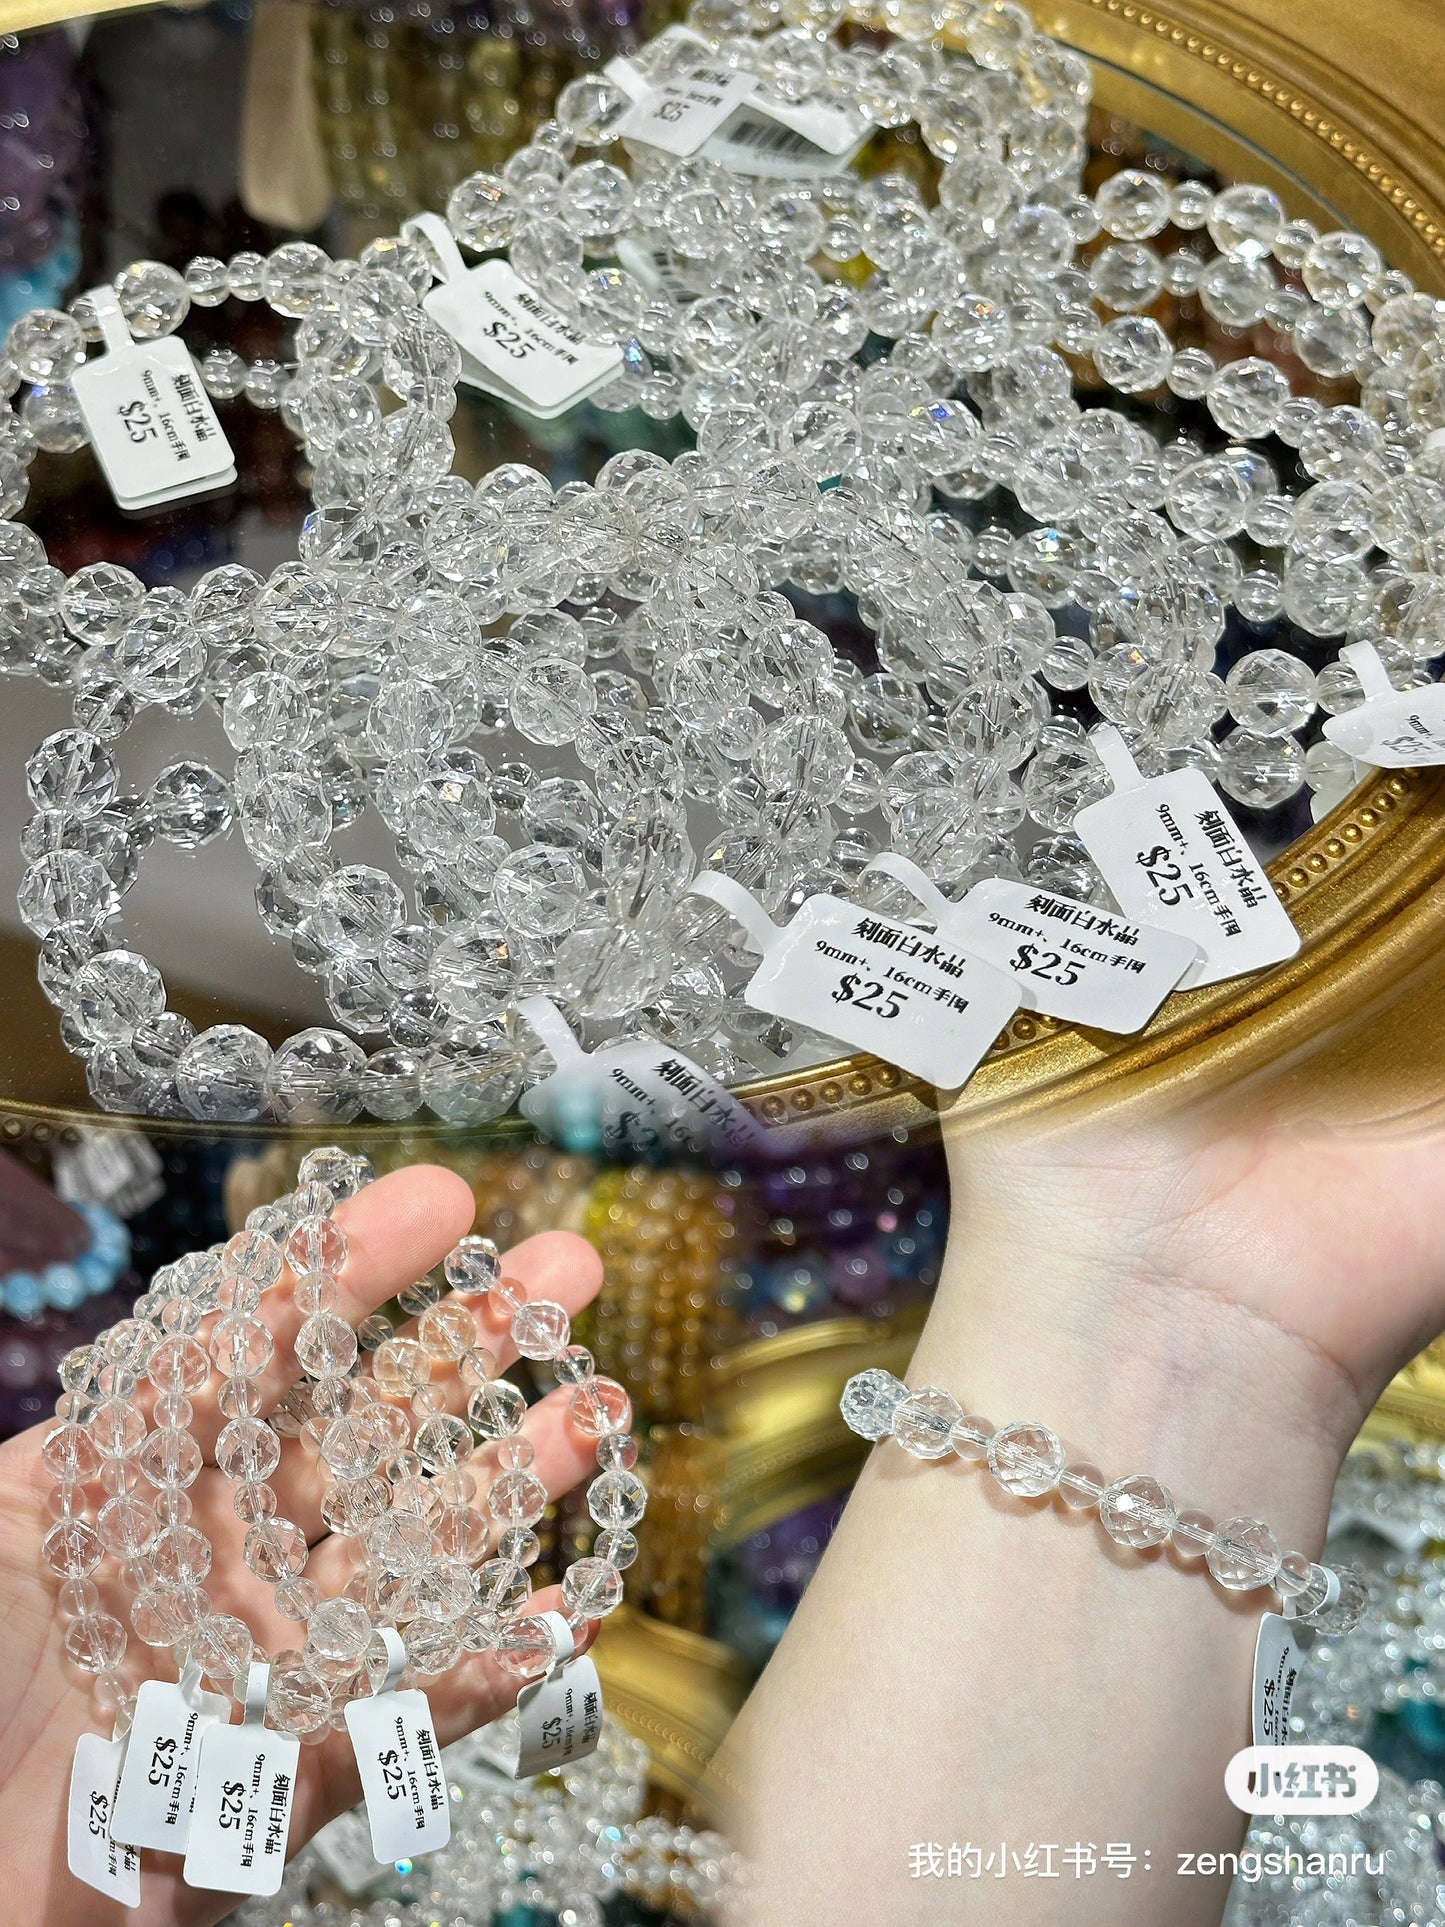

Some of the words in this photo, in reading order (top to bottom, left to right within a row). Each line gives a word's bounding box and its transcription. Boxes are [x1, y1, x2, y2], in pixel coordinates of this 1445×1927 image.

[483, 321, 536, 360] $25
[118, 401, 159, 443] $25
[1135, 845, 1195, 907] $25
[1193, 809, 1267, 909] 刻面白水晶
[1023, 894, 1140, 947] 刻面白水晶
[851, 917, 966, 979] 刻面白水晶
[1009, 943, 1086, 986] $25
[831, 973, 909, 1020] $25
[540, 1716, 562, 1749] $25
[1263, 1678, 1276, 1737] $25
[148, 1736, 179, 1788] $25
[377, 1749, 407, 1801] $25
[416, 1728, 444, 1812] 刻面白水晶
[89, 1790, 111, 1840] $25
[218, 1780, 247, 1831] $25
[264, 1771, 291, 1856] 刻面白水晶
